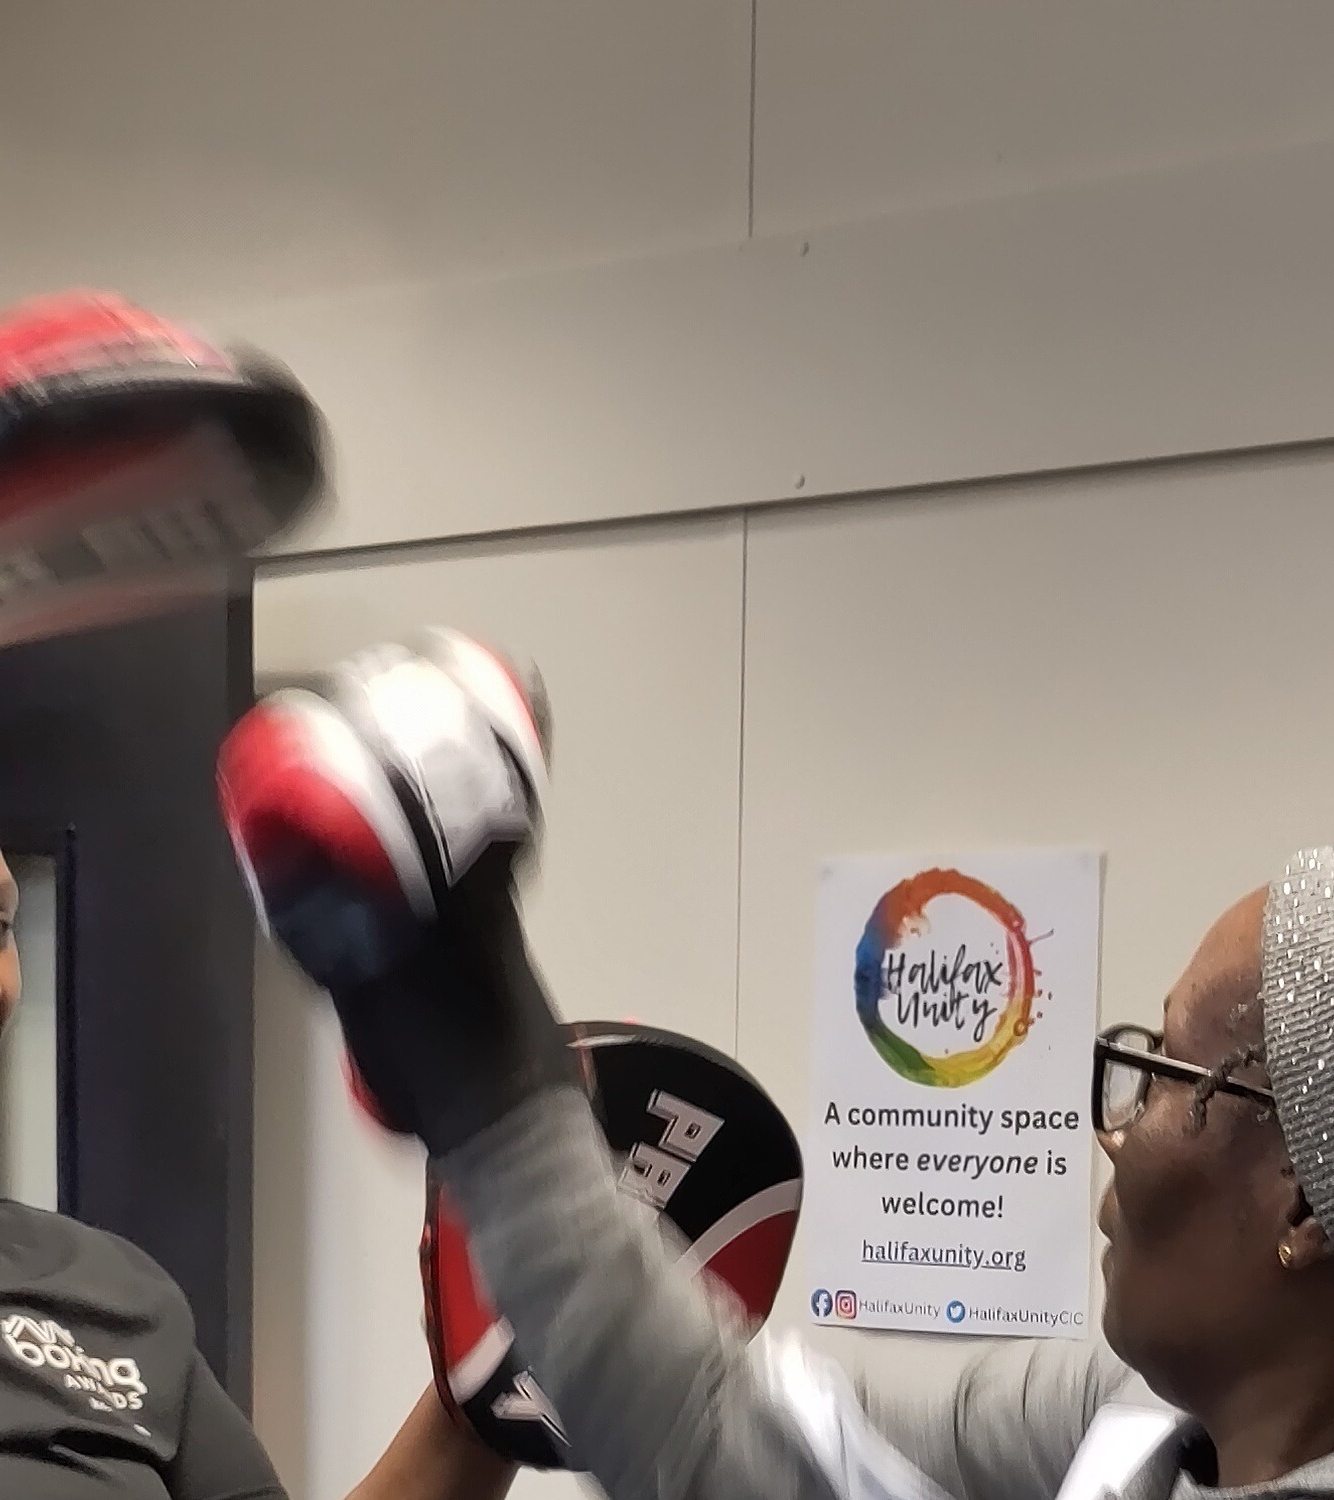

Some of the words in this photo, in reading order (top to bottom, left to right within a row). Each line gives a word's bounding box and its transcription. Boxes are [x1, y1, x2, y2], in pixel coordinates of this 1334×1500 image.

[887, 944, 1003, 996] Halifax
[897, 991, 998, 1042] Unity
[824, 1101, 840, 1126] A
[847, 1103, 993, 1135] community
[1000, 1109, 1080, 1135] space
[832, 1145, 909, 1170] where
[916, 1152, 1039, 1180] everyone
[1046, 1150, 1067, 1176] is
[881, 1191, 1004, 1218] welcome!
[861, 1239, 1027, 1272] halifaxunity.org
[858, 1299, 941, 1319] HalifaxUnity
[968, 1306, 1085, 1327] HalifaxUnityCIC
